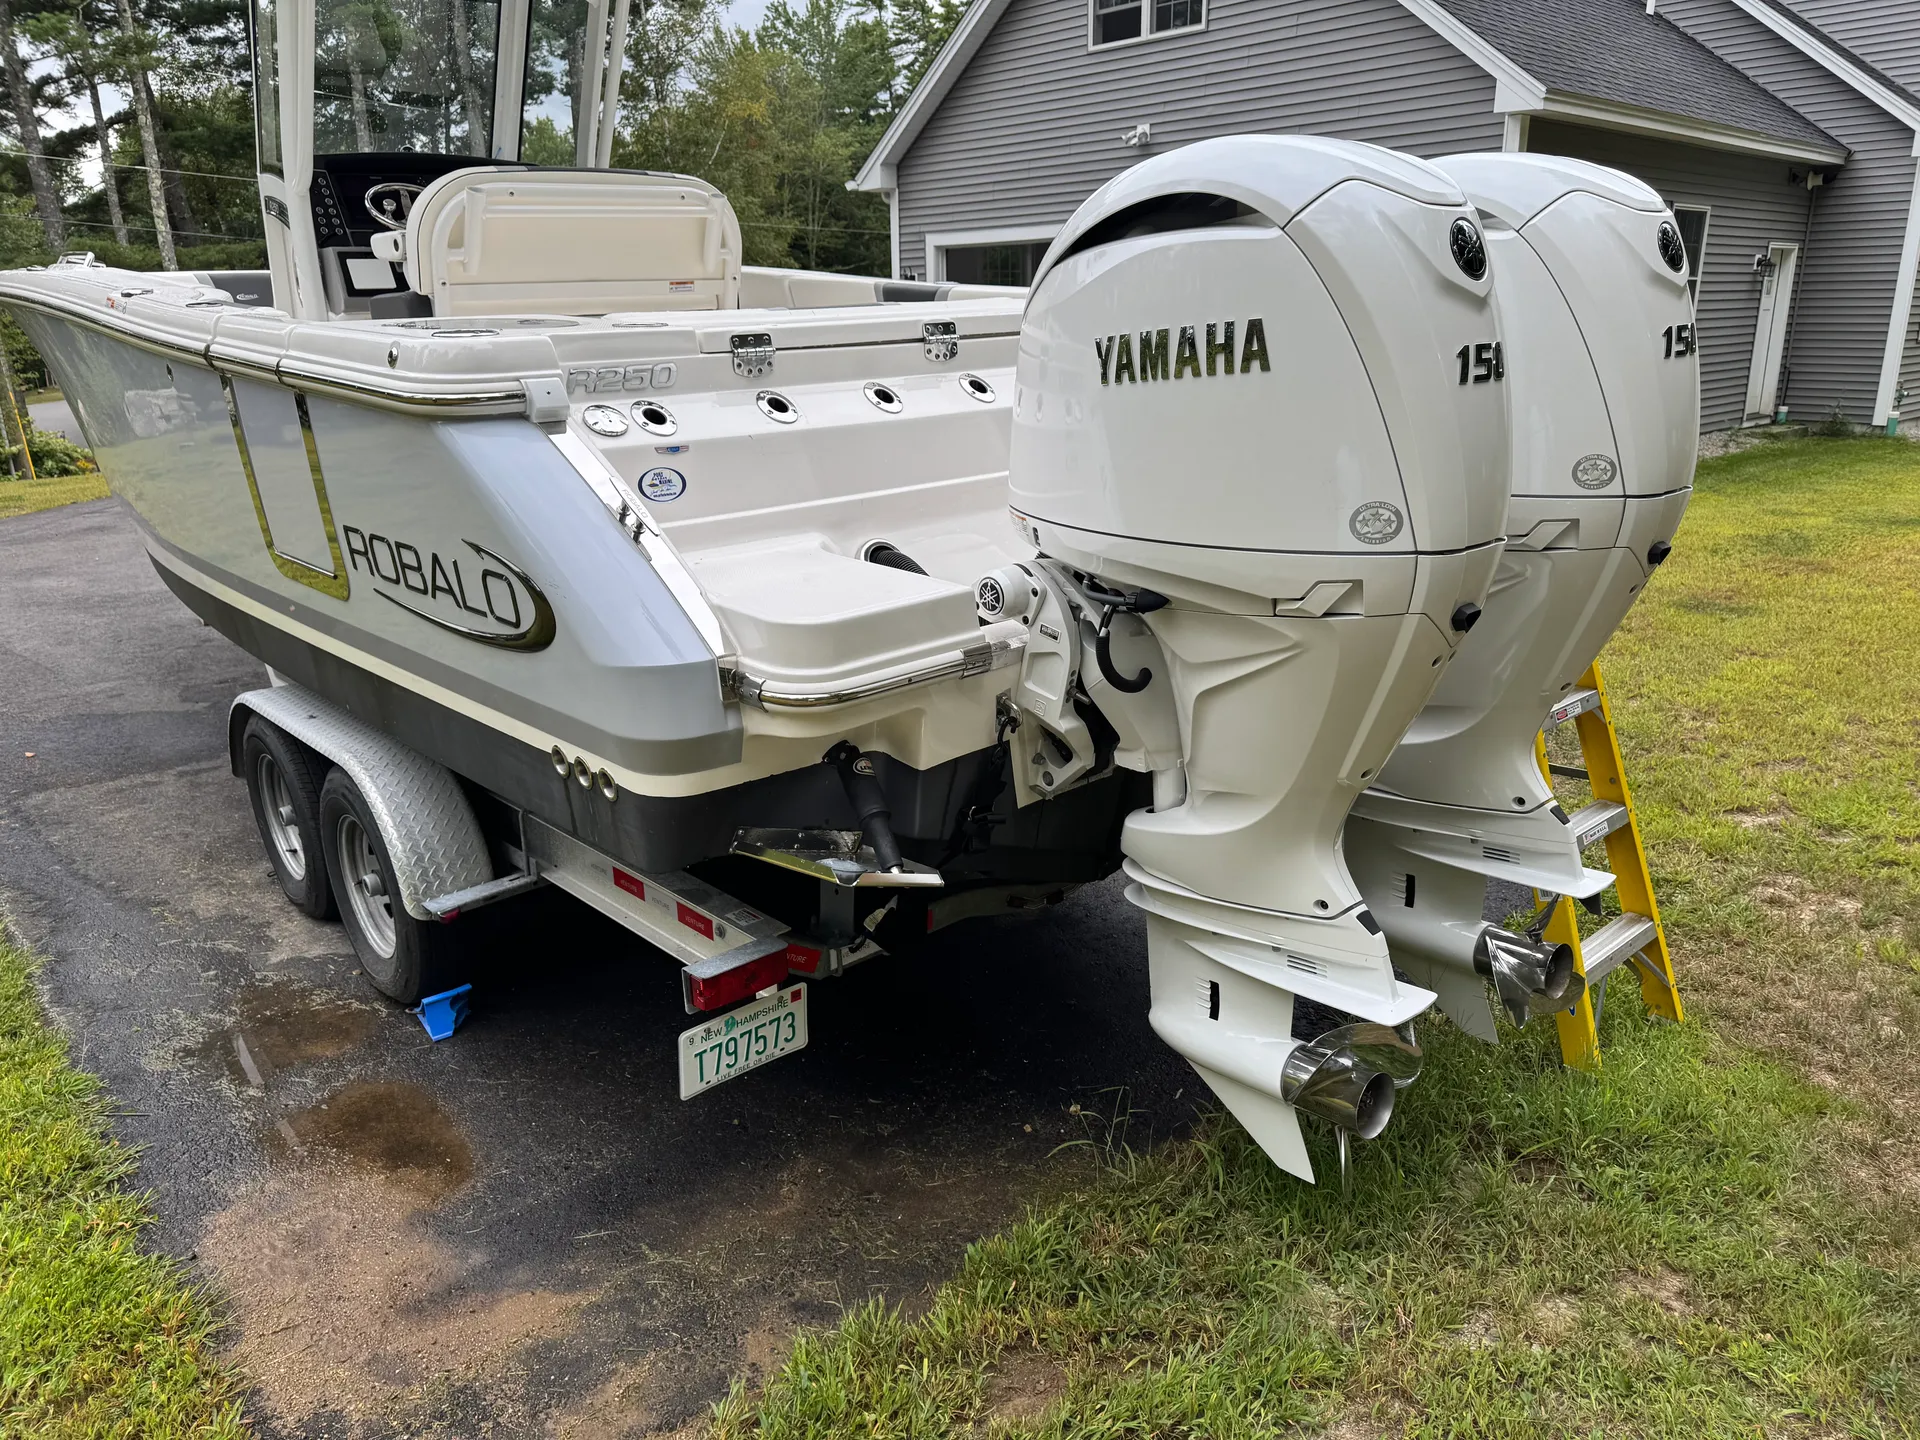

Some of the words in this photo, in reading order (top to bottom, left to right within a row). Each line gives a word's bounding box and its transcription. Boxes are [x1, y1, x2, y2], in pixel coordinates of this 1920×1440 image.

[1094, 317, 1271, 386] YAMAHA
[1456, 341, 1504, 385] 150
[566, 362, 678, 395] R250
[342, 524, 521, 629] ROBALO
[684, 915, 705, 931] VENTURE
[688, 1037, 695, 1046] 9
[700, 1026, 723, 1044] NEW
[736, 998, 789, 1029] HAMPSHIRE
[693, 1011, 796, 1083] T797573
[716, 1072, 732, 1082] LIVE
[734, 1063, 751, 1075] FREE
[753, 1057, 762, 1066] OR
[765, 1051, 777, 1061] DIE
